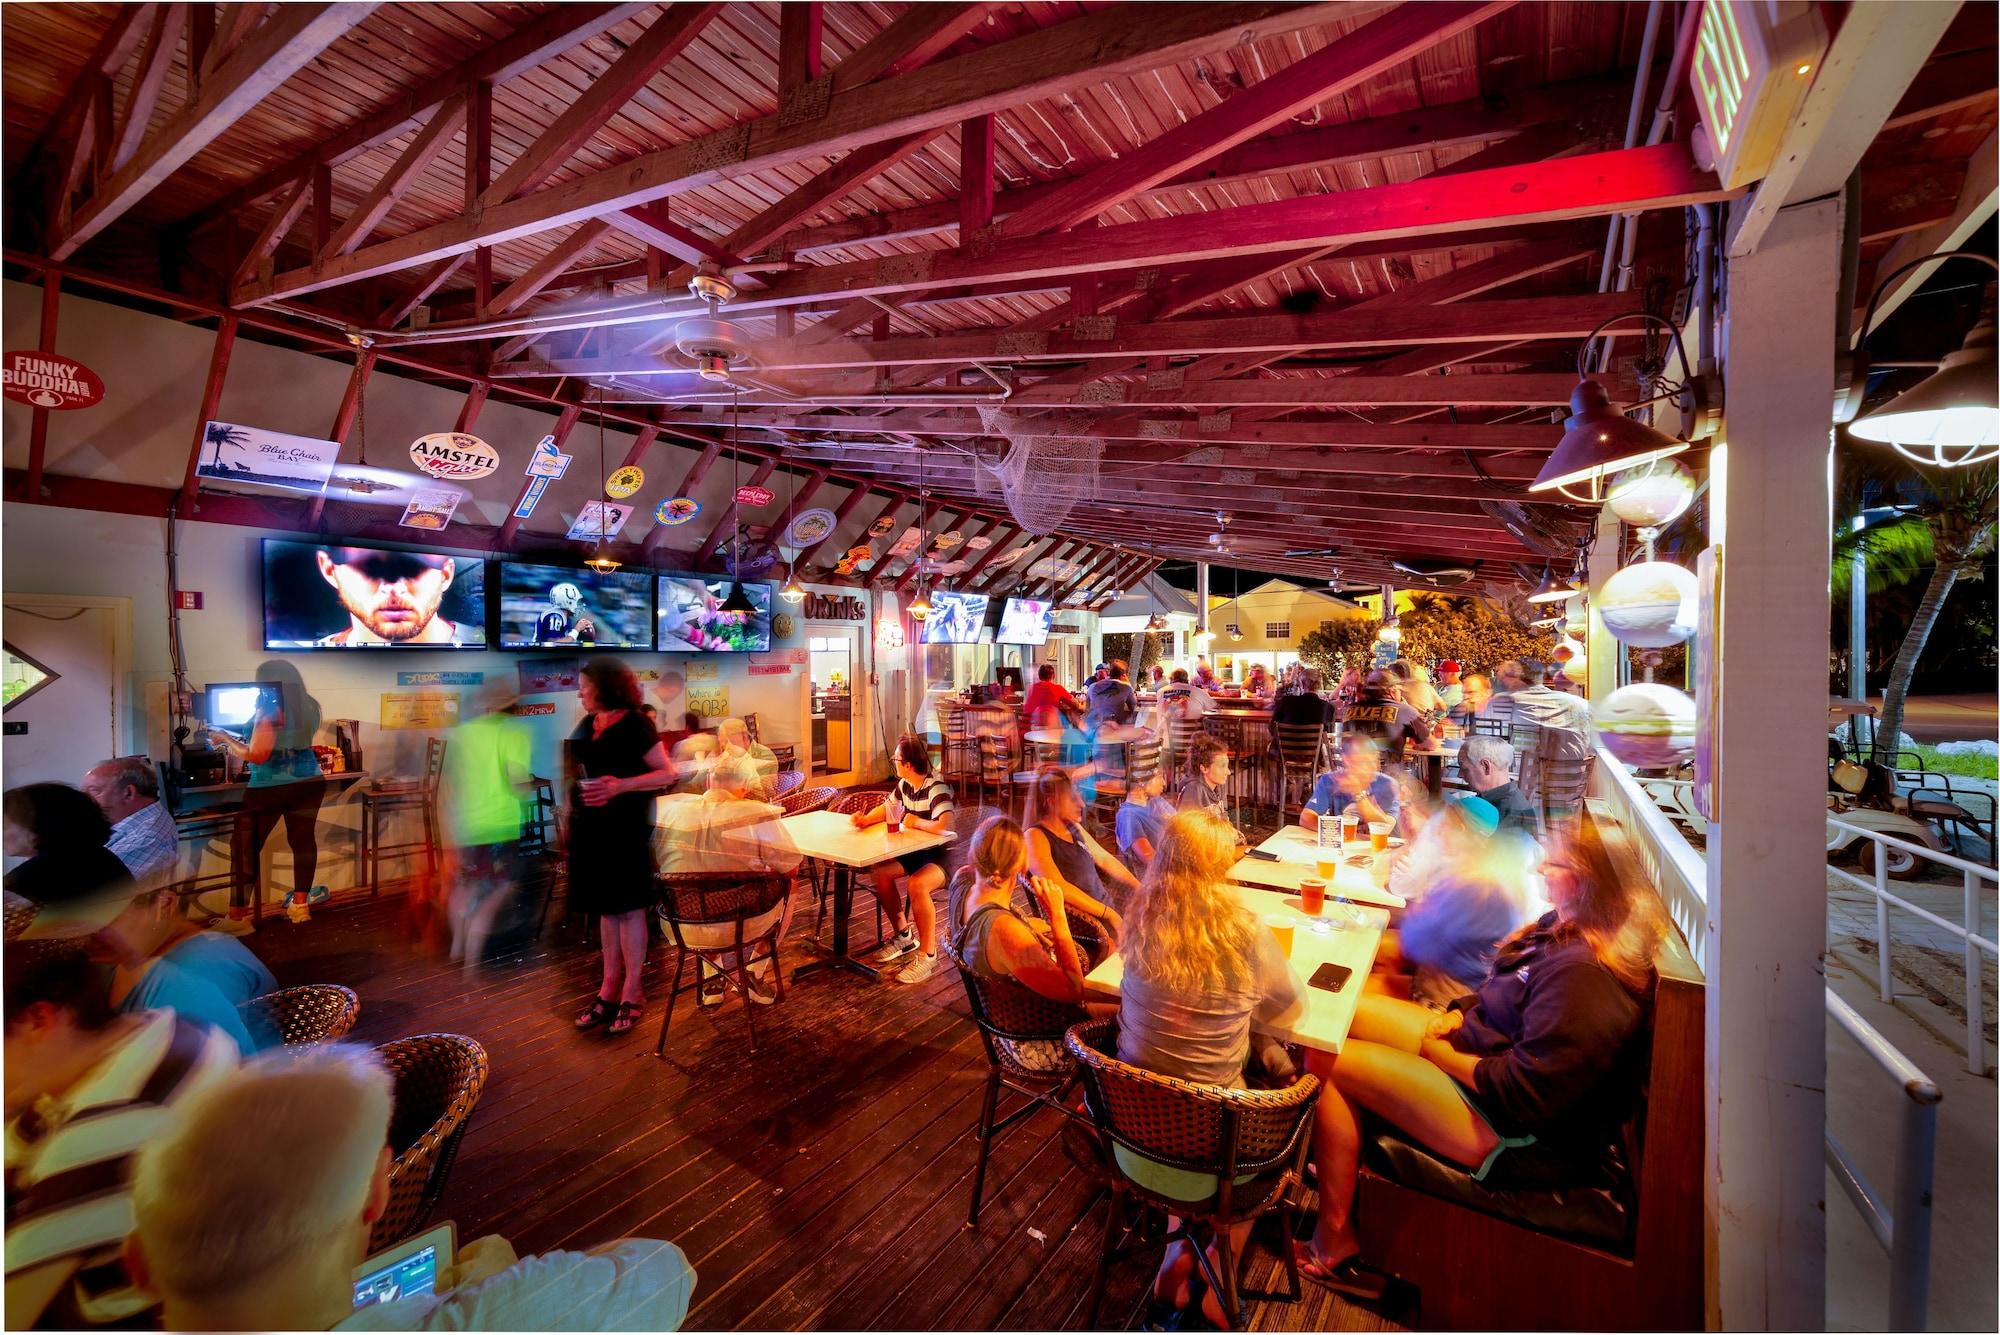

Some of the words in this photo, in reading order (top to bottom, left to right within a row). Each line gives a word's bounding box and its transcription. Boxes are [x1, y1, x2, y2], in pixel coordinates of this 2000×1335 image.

[15, 355, 79, 380] FUNKY
[2, 368, 80, 395] BUDDHA
[258, 444, 289, 455] Blue
[290, 448, 322, 462] Chair
[277, 454, 302, 462] BAY
[413, 441, 496, 469] AMSTEL
[610, 484, 631, 494] IPA
[803, 591, 866, 620] DRINKS
[689, 699, 728, 718] SOB?
